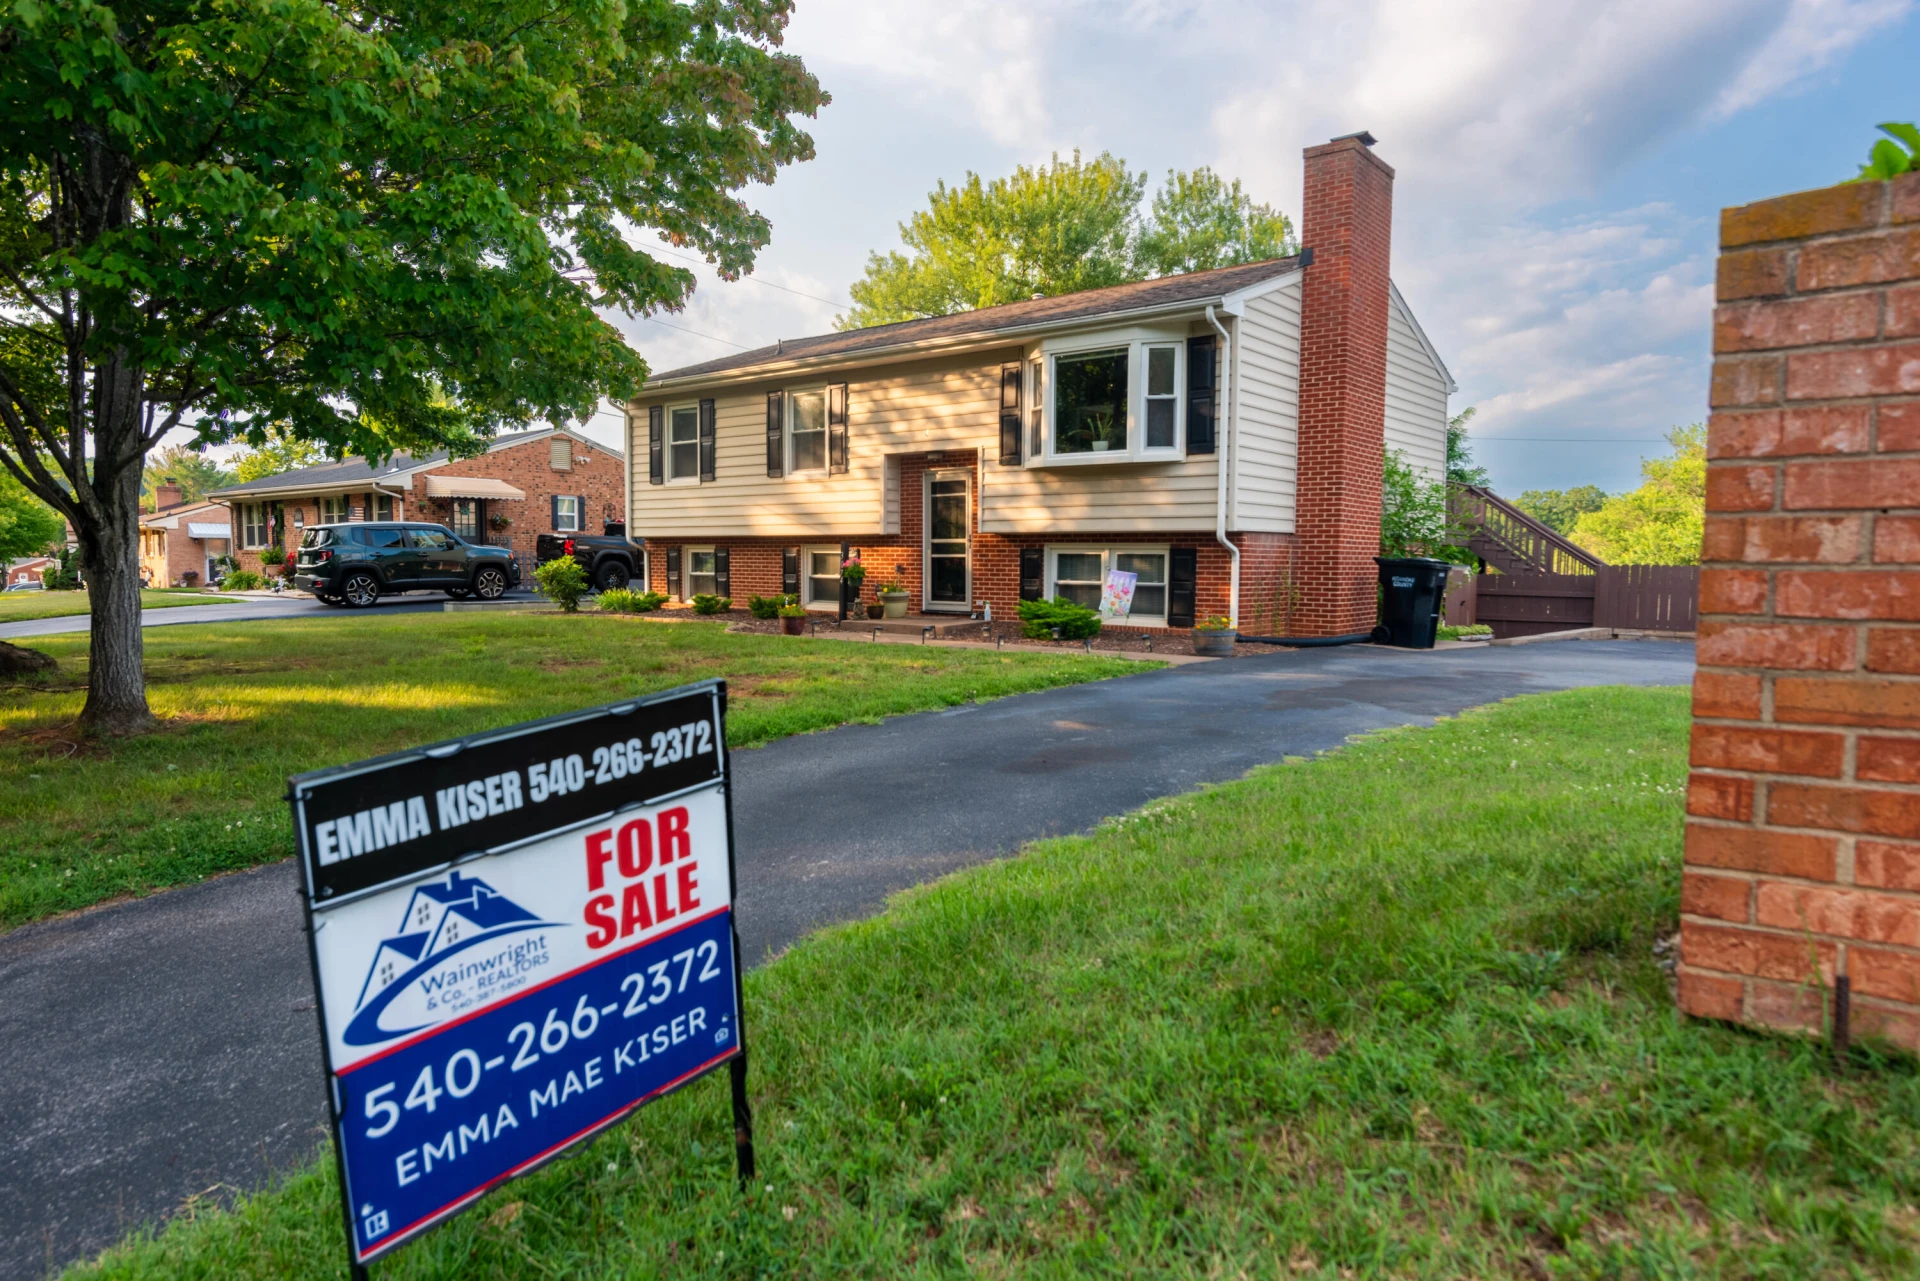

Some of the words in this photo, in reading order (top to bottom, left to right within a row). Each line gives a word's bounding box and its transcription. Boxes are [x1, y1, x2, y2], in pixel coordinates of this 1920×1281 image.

[316, 796, 431, 867] EMMA
[435, 770, 524, 831] KISER
[528, 719, 714, 803] 540-266-2372
[584, 806, 692, 893] FOR
[583, 861, 700, 951] SALE
[420, 934, 547, 995] Wainwright
[427, 997, 438, 1011] &
[441, 987, 466, 1004] Co.
[477, 951, 550, 990] REALTORS
[364, 939, 721, 1139] 540-266-2372
[395, 1103, 520, 1188] EMMA
[529, 1056, 604, 1118] MAE
[614, 1006, 709, 1074] KISER
